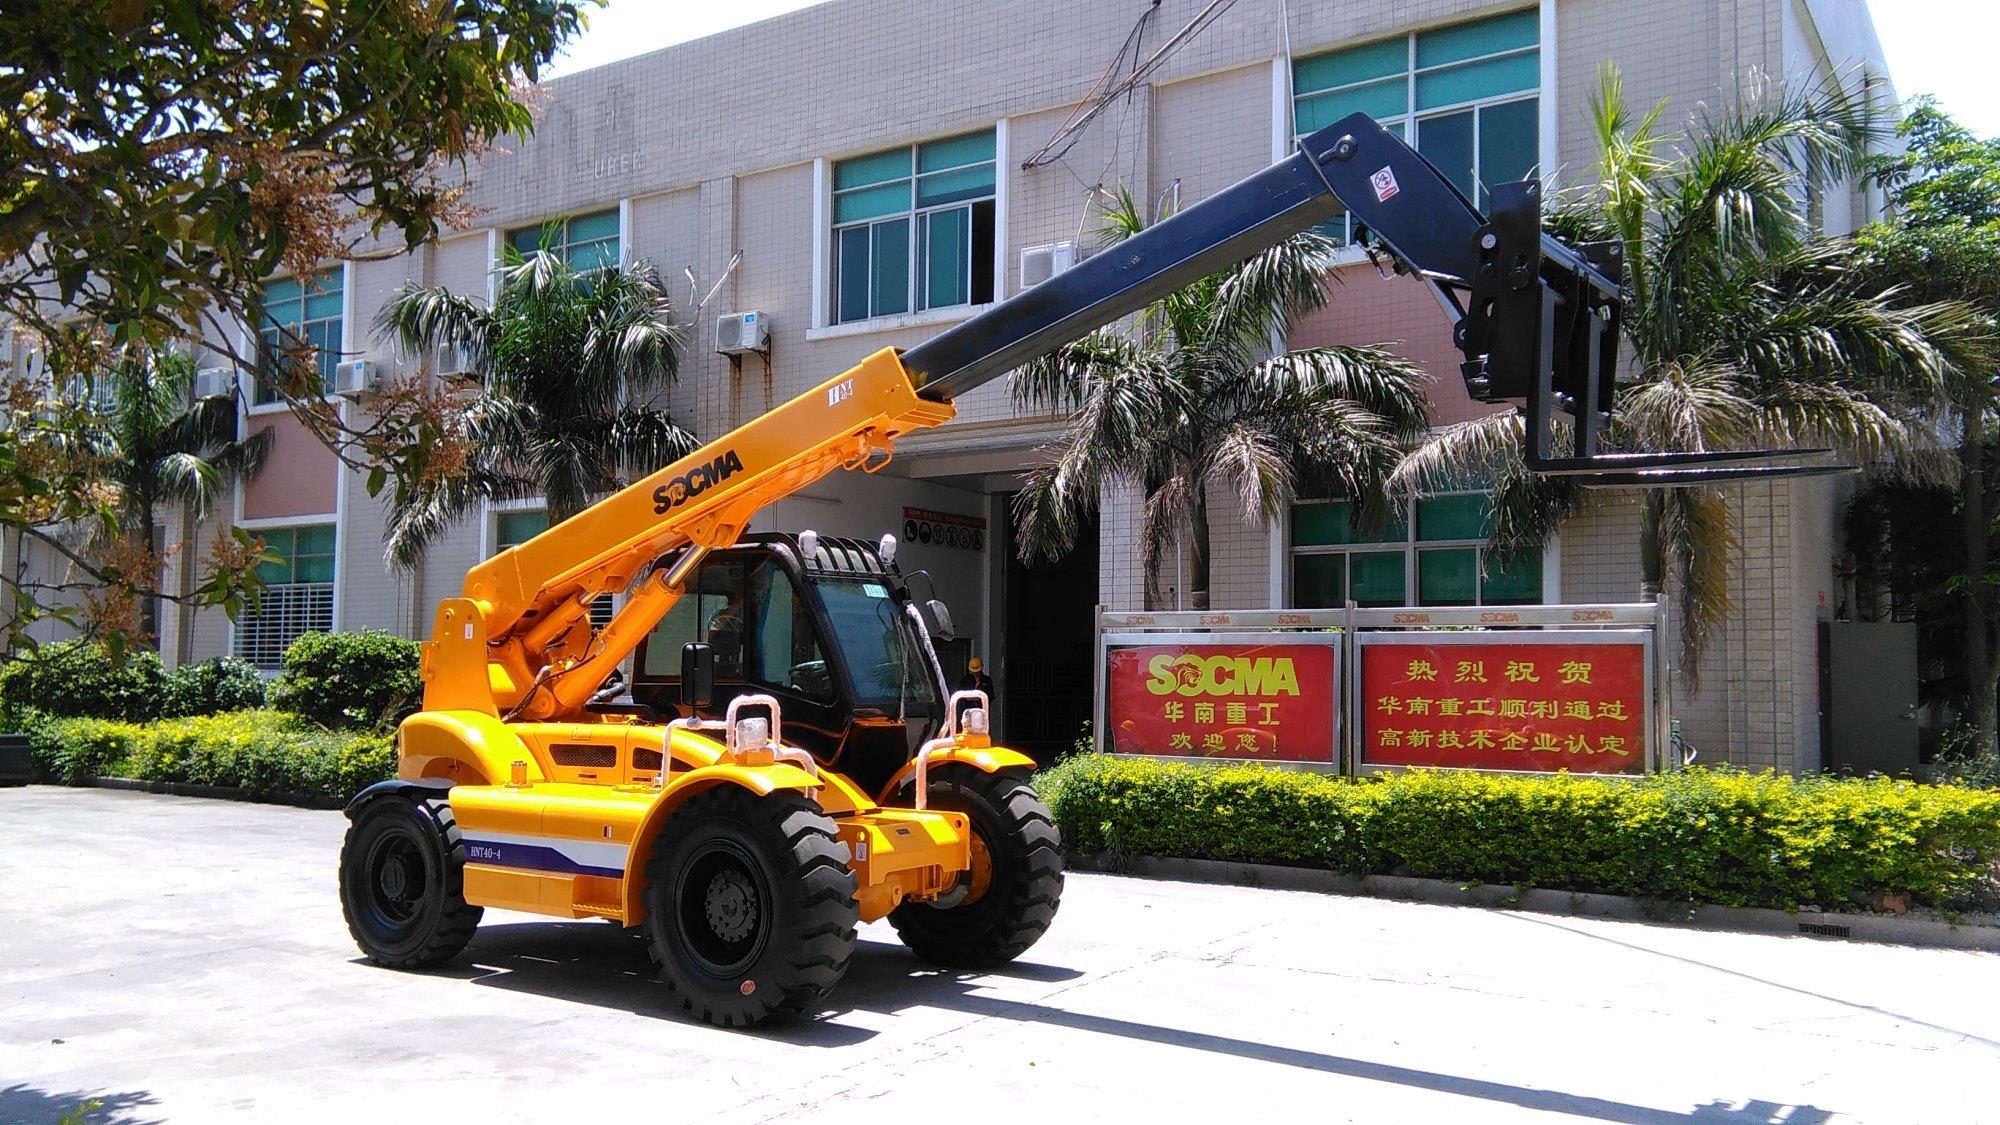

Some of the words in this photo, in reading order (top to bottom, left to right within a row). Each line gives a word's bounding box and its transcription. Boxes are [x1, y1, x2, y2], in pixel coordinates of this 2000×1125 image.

[652, 449, 744, 515] SOCMA
[1126, 616, 1155, 625] SOCMA
[1200, 616, 1230, 625] SOCMA
[1278, 615, 1311, 624] SOCMA
[1394, 613, 1430, 624] SOCMA
[1480, 612, 1519, 623] SOCMA
[1572, 610, 1613, 621] SOCMA
[1146, 654, 1300, 697] SOCMA
[1405, 660, 1592, 684] 热烈祝贺
[1164, 701, 1280, 725] 华南重工
[1377, 696, 1629, 720] 华南重工顺利通过
[1377, 728, 1630, 757] 高新技术企业认定
[470, 846, 501, 860] HNT40-4
